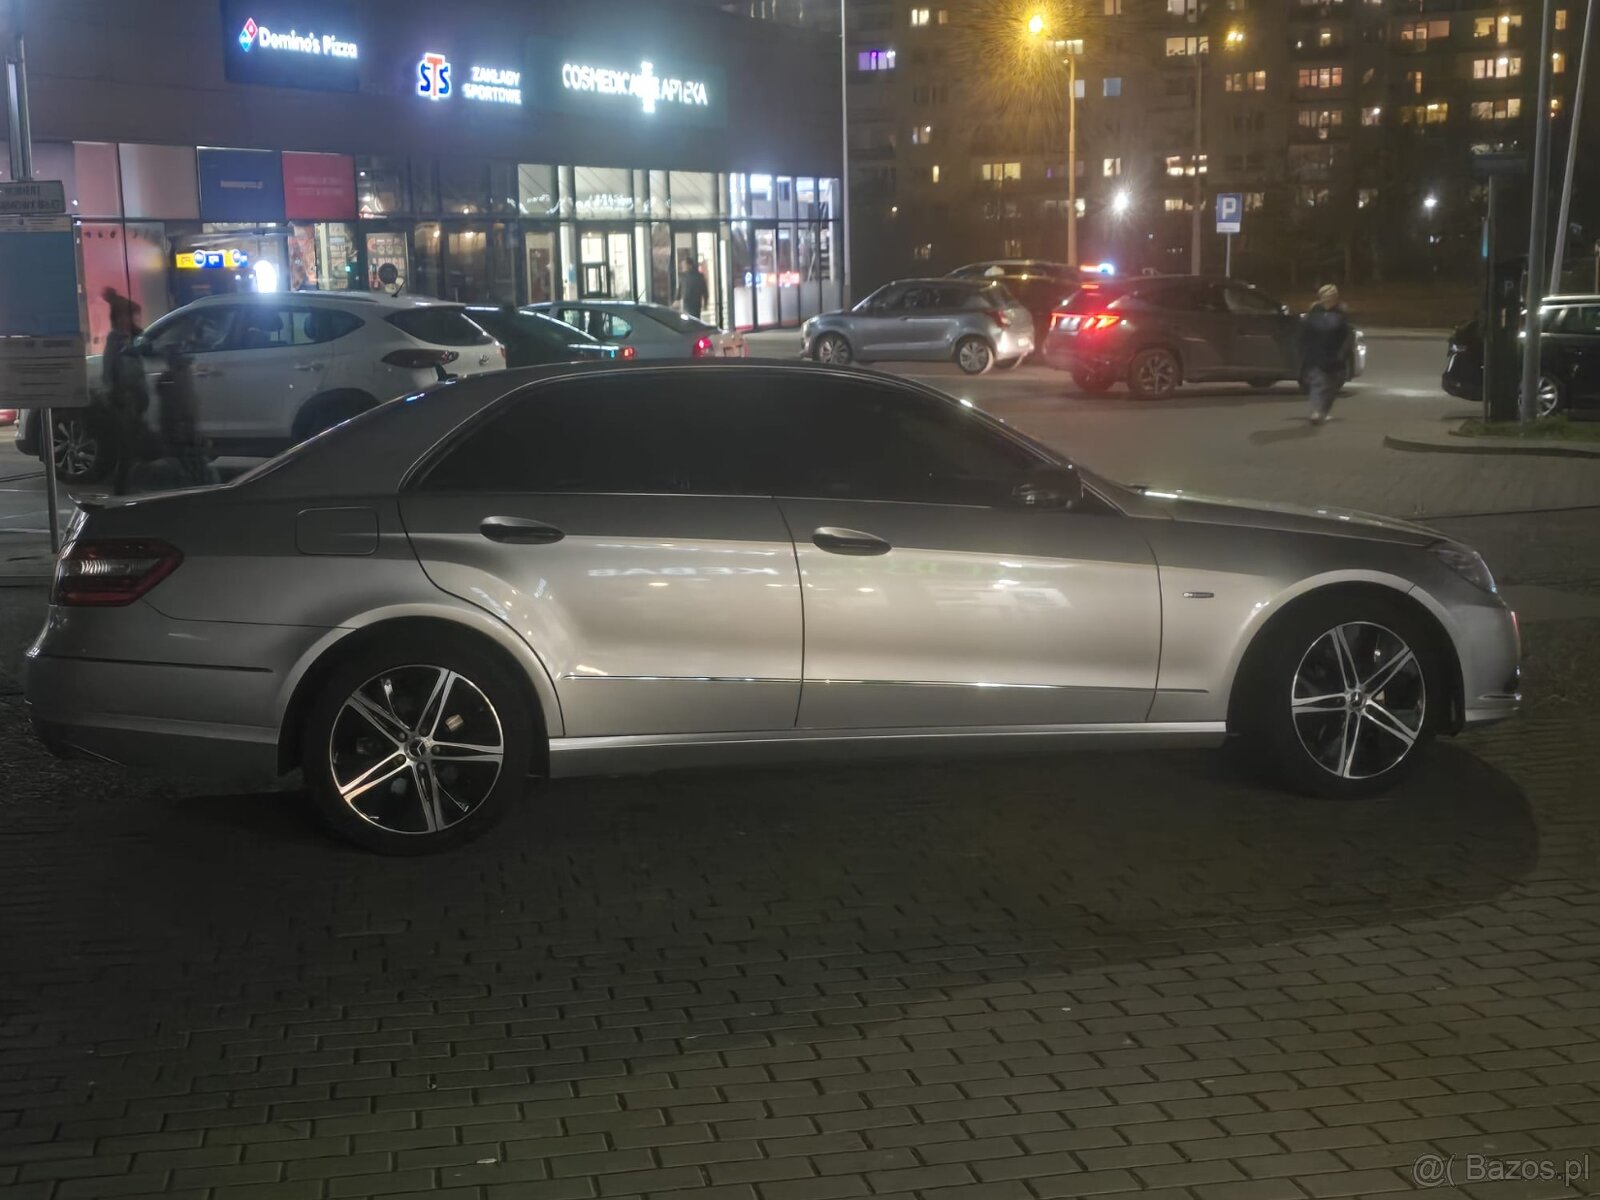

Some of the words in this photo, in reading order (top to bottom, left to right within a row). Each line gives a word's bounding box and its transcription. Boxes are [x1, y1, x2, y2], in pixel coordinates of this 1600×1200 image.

[259, 26, 320, 54] Domino's
[322, 34, 358, 59] Pizza
[418, 53, 451, 100] STS
[462, 83, 522, 104] SPORTOWE
[660, 78, 708, 105] APTEKA
[1222, 197, 1236, 220] P
